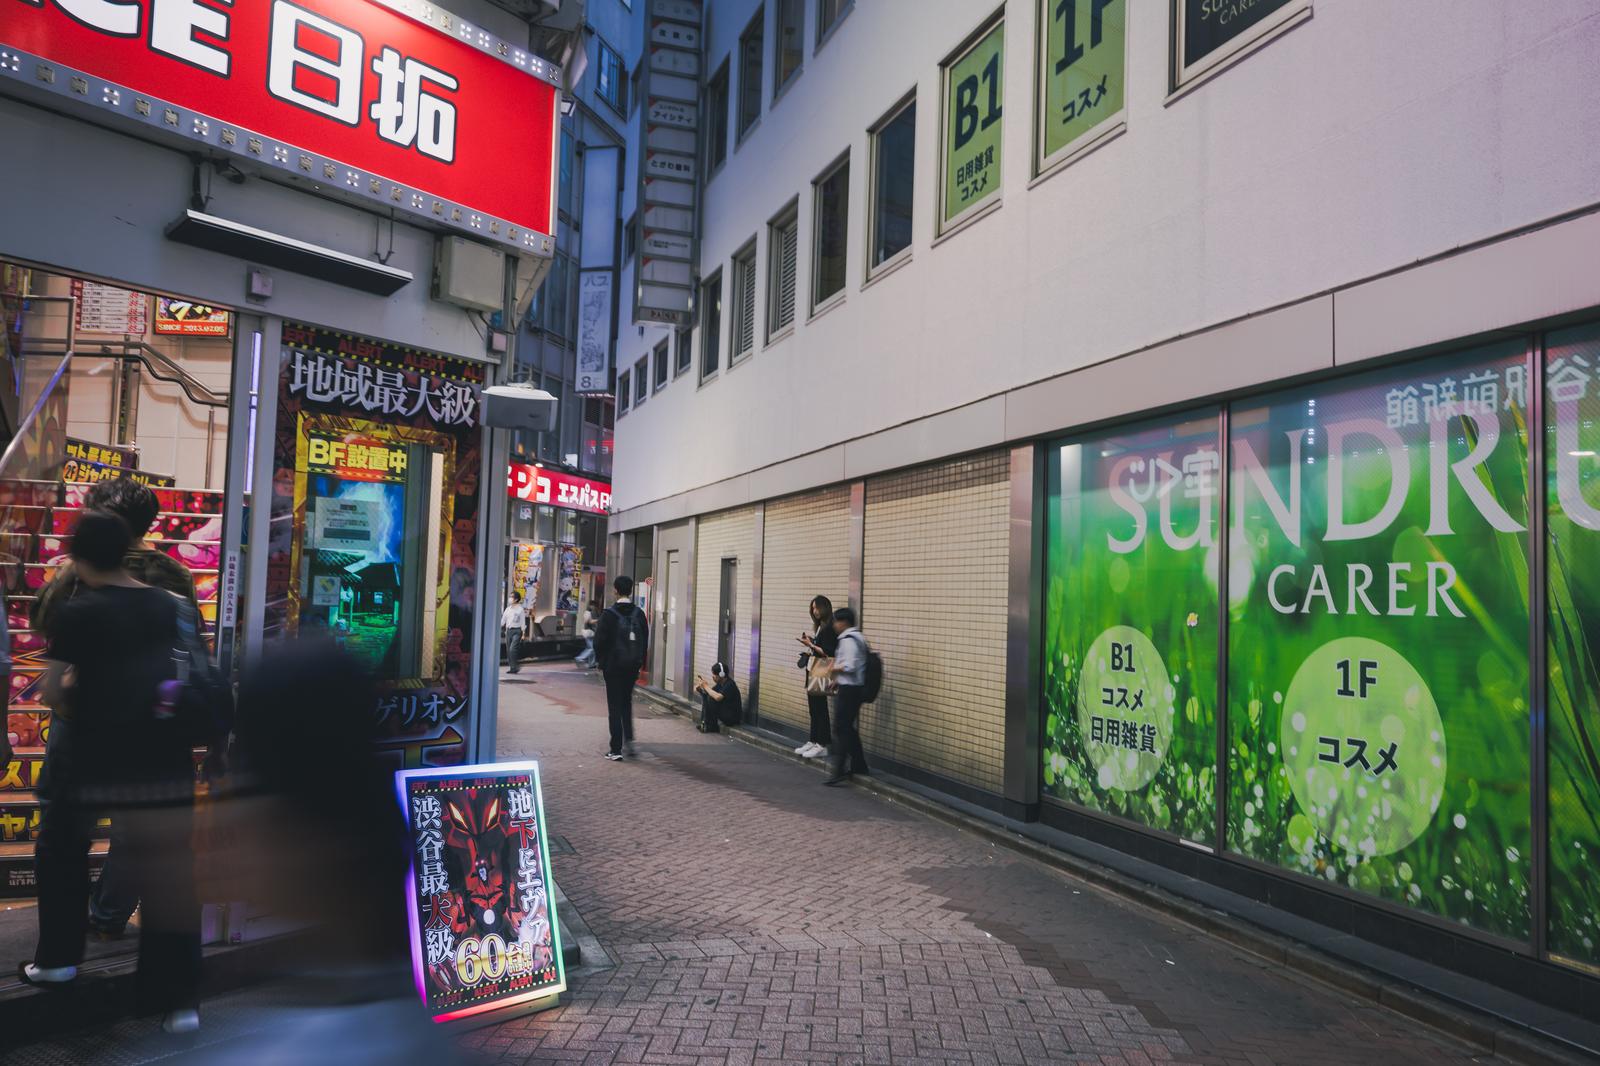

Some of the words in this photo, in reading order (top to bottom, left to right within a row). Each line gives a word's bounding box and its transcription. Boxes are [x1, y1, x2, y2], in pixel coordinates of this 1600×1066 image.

[267, 0, 458, 164] 日拓
[954, 52, 1002, 152] B1
[1062, 74, 1107, 125] コスメ
[956, 145, 994, 187] 日用雑貨
[961, 171, 987, 202] コスメ
[283, 328, 316, 343] ERT
[338, 338, 384, 359] ALERT
[404, 352, 446, 372] ALERT
[290, 352, 477, 428] 地域最大級
[308, 438, 407, 473] BFに設置中
[558, 482, 612, 510] エスパス日
[1267, 561, 1467, 619] CARER
[1111, 642, 1136, 673] B1
[1336, 659, 1378, 698] 1F
[1102, 687, 1144, 711] コスメ
[1090, 716, 1157, 754] 日用雑貨
[1317, 736, 1399, 776] コスメ
[412, 795, 456, 965] 渋谷最大級
[474, 983, 499, 997] ALERT
[509, 976, 533, 989] ALERT
